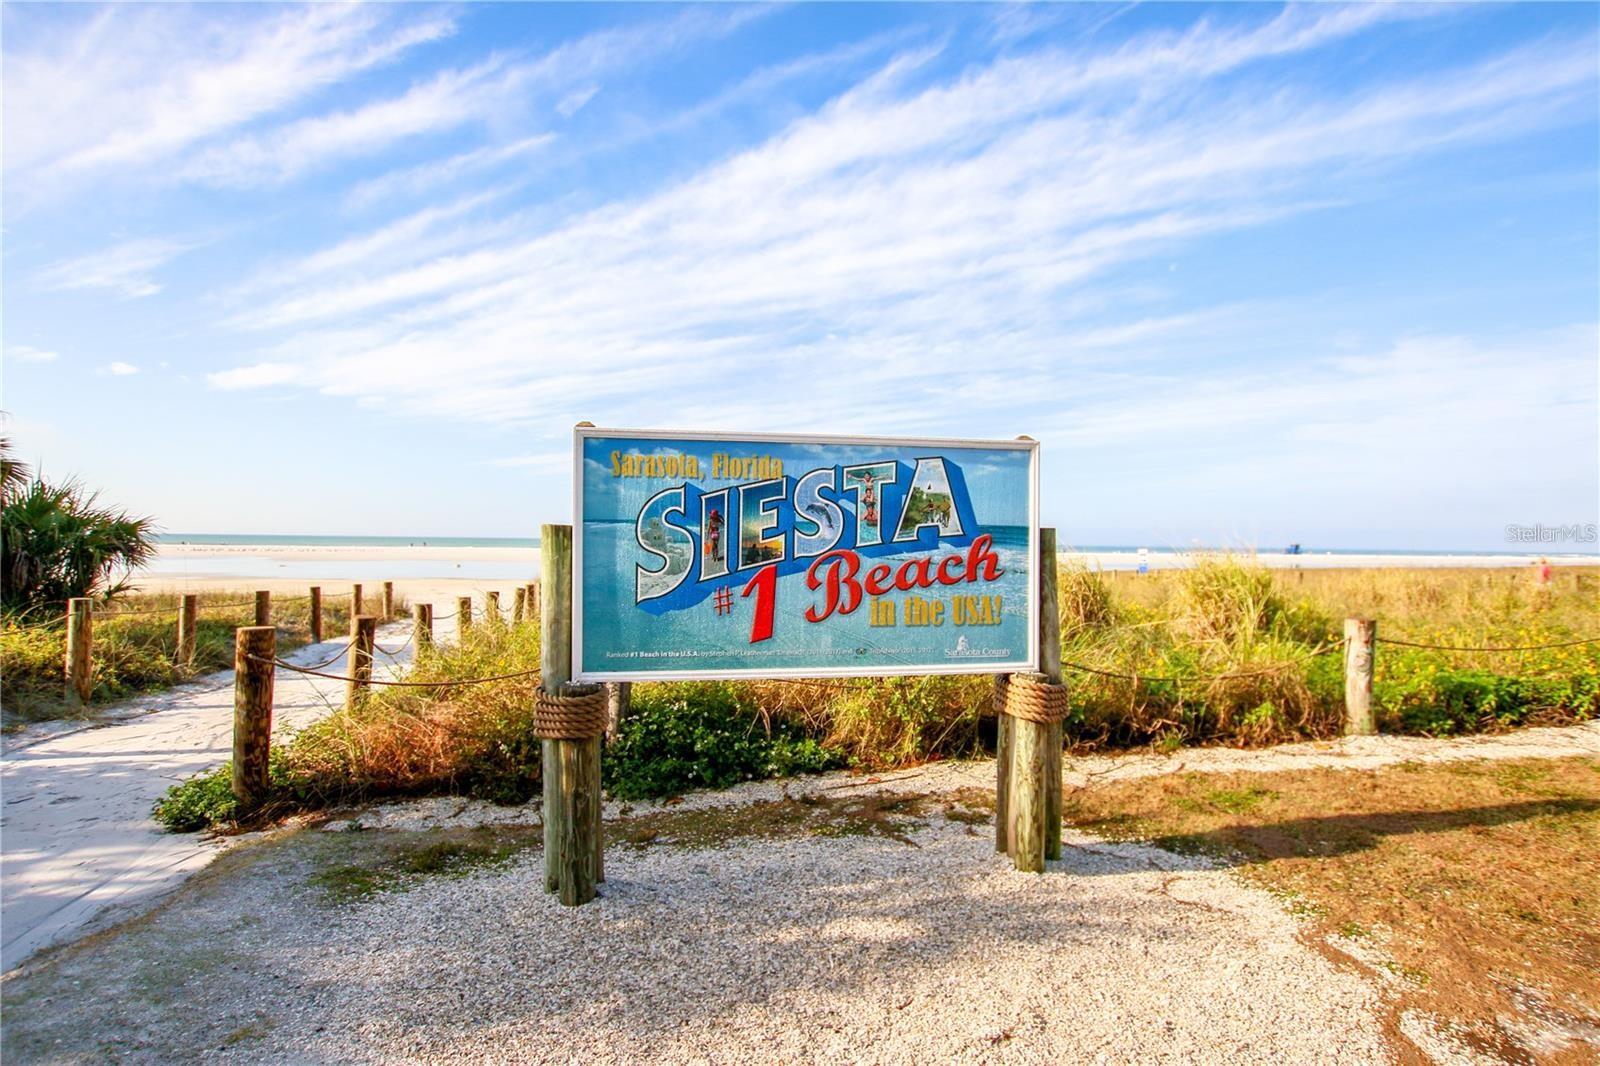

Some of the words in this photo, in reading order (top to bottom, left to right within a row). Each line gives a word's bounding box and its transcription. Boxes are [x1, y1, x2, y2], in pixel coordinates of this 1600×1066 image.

[610, 451, 705, 481] Sarasota,
[711, 453, 783, 480] Florida
[635, 456, 966, 606] SIESTA
[713, 564, 778, 643] #1
[804, 534, 1006, 623] Beach
[870, 596, 896, 627] in
[904, 596, 945, 626] the
[952, 594, 1002, 626] USA!
[945, 648, 981, 657] Sarasota
[982, 647, 1011, 657] County
